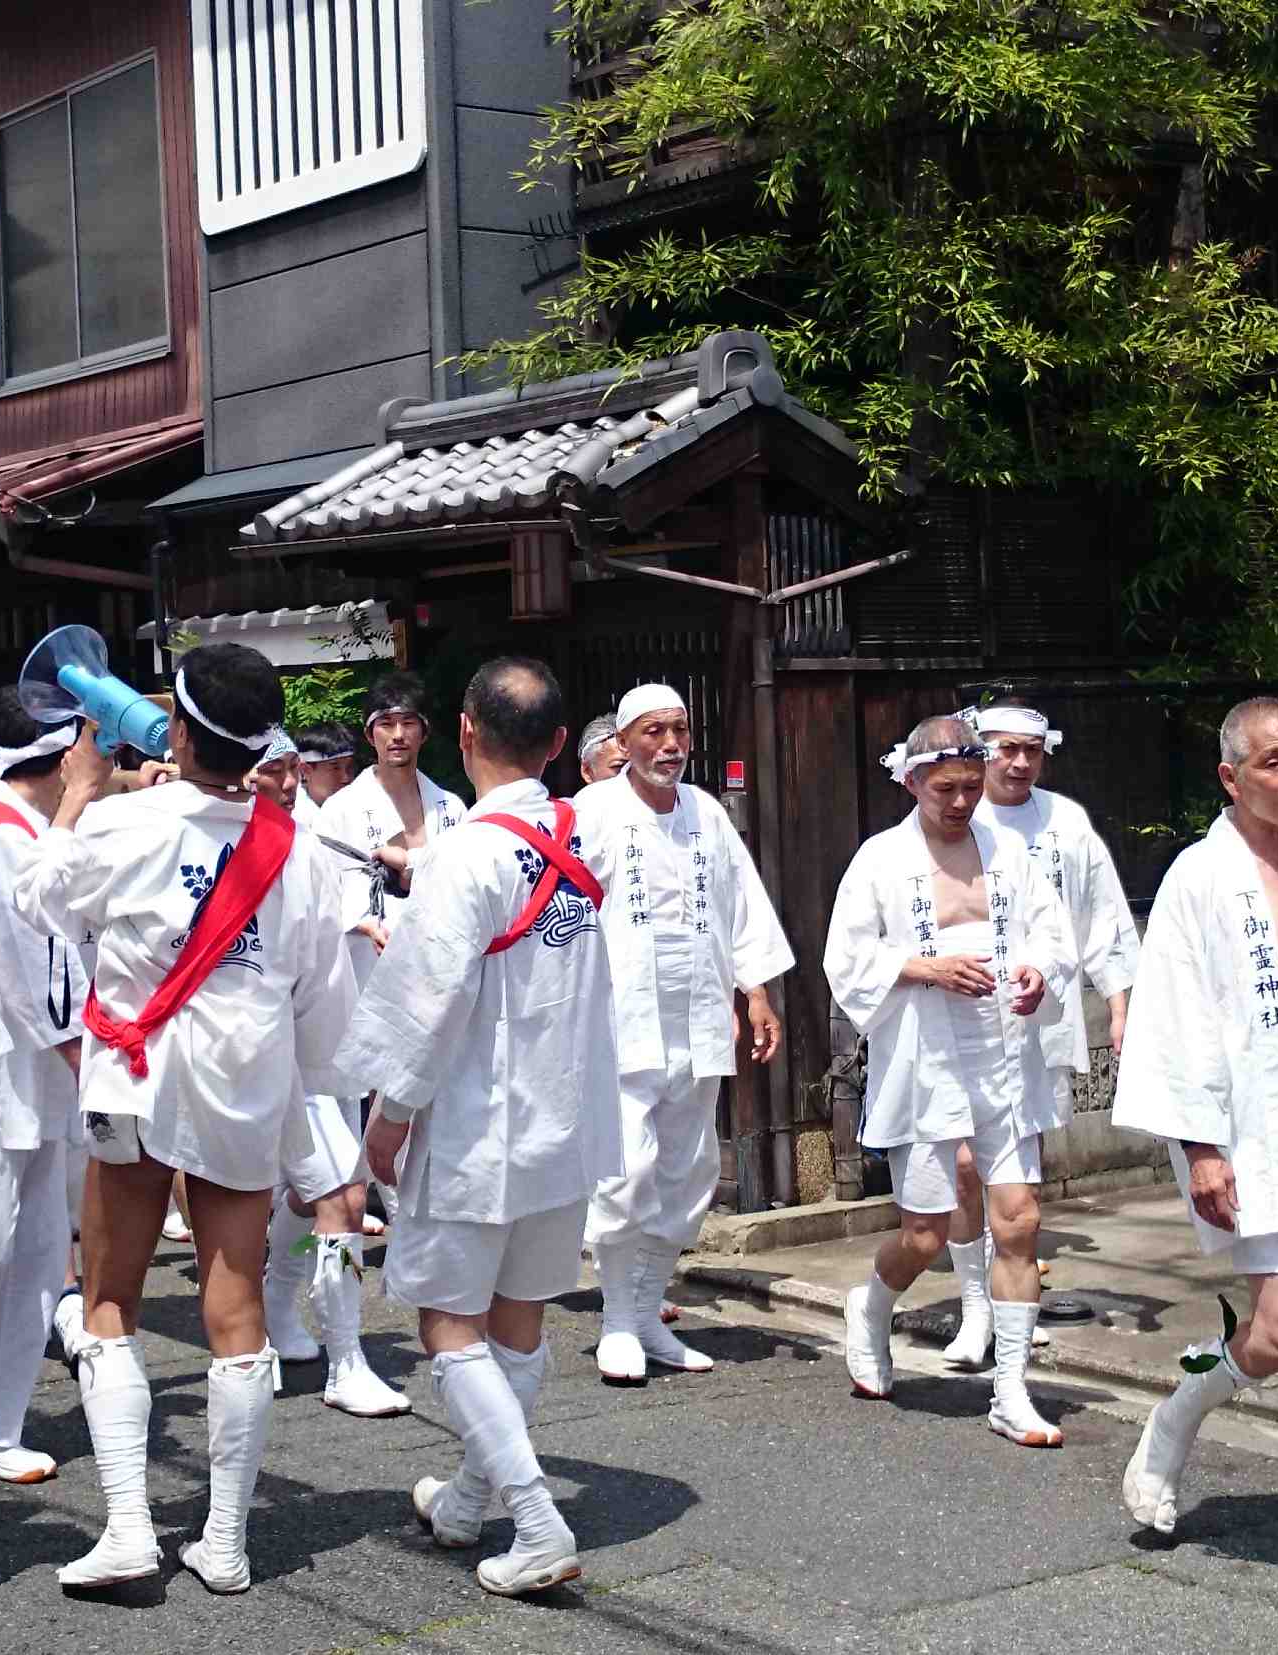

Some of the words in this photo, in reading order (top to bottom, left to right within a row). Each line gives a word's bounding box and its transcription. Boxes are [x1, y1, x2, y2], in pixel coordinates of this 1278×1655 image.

[623, 825, 650, 928] 下御霊神社
[688, 831, 710, 935] 下御霊神社
[984, 870, 1009, 984] 下御霊神社
